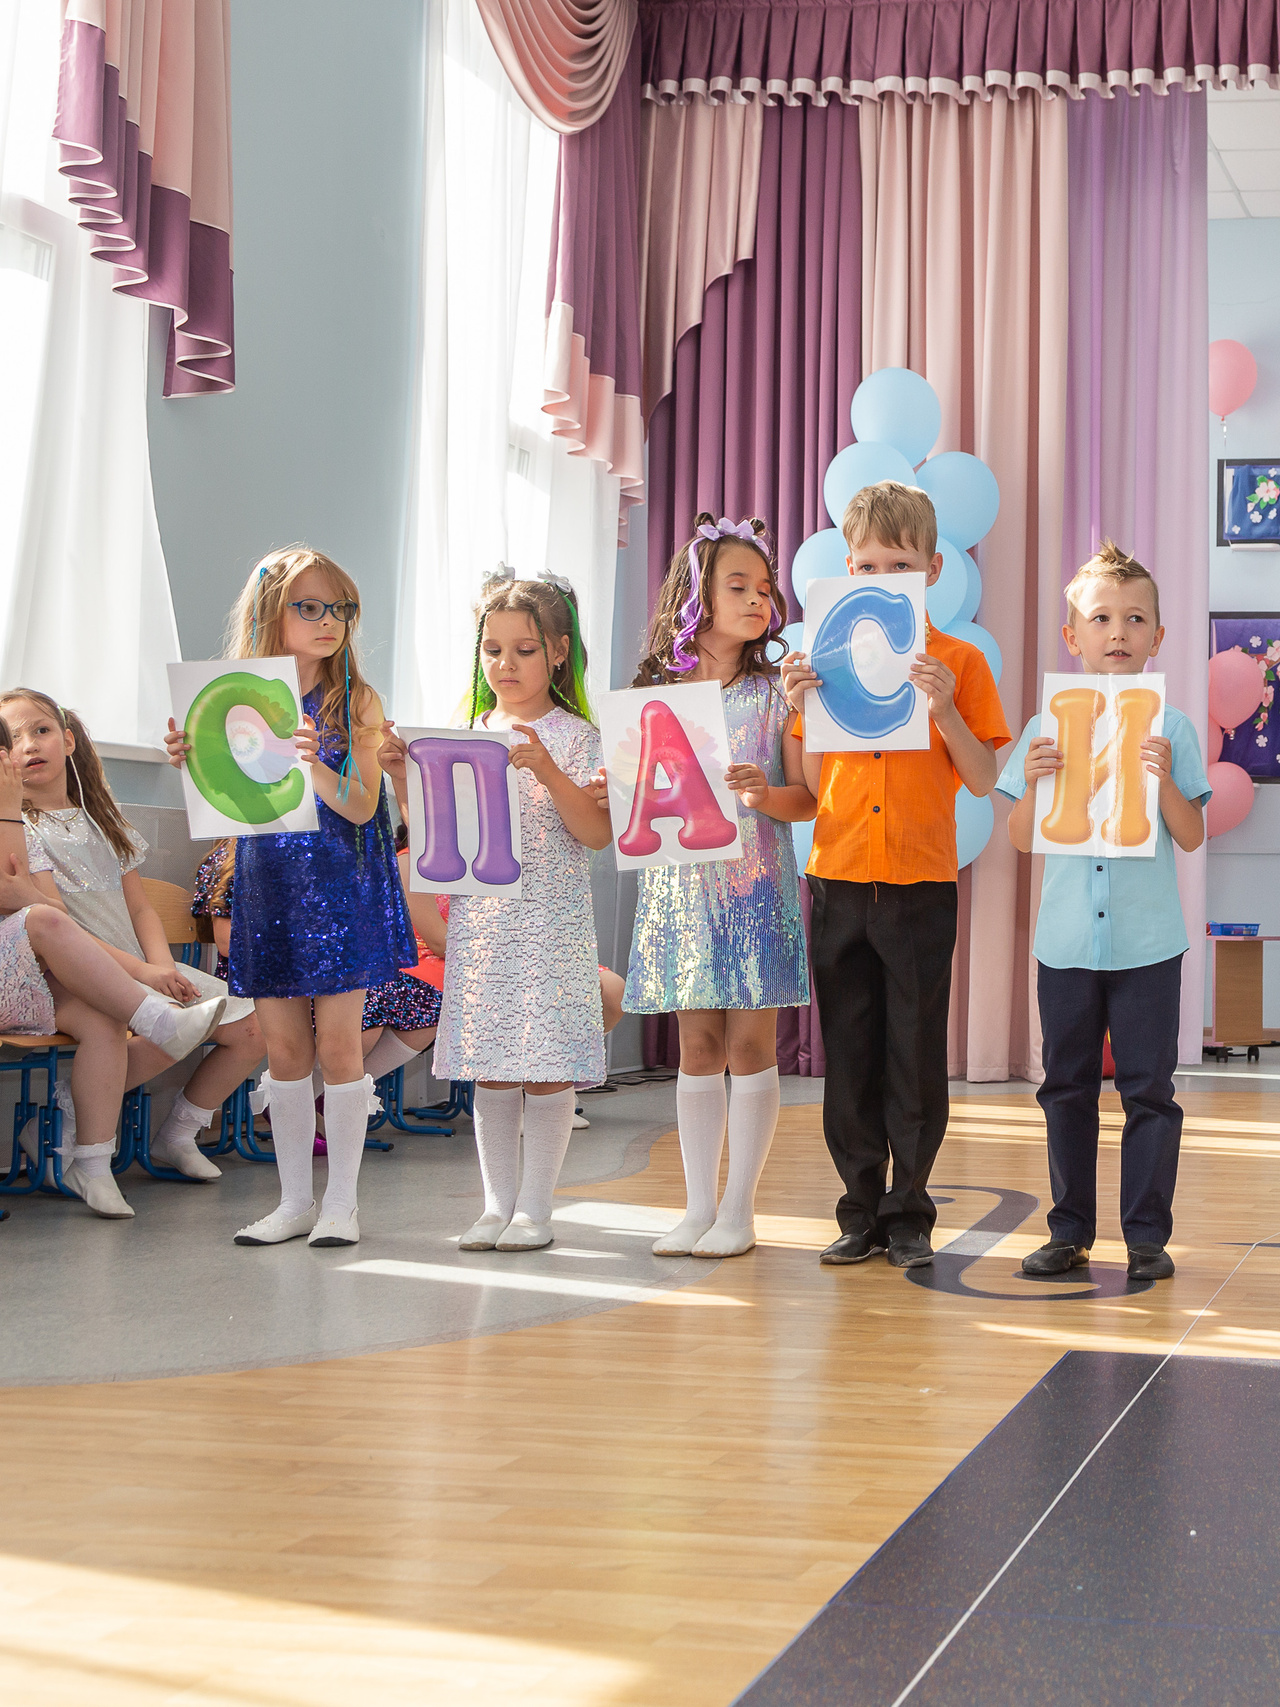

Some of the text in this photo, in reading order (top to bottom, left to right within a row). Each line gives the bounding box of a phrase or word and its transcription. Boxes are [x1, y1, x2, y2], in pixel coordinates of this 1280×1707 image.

[408, 737, 521, 885] П
[618, 700, 737, 857] А
[1041, 688, 1161, 847] И
